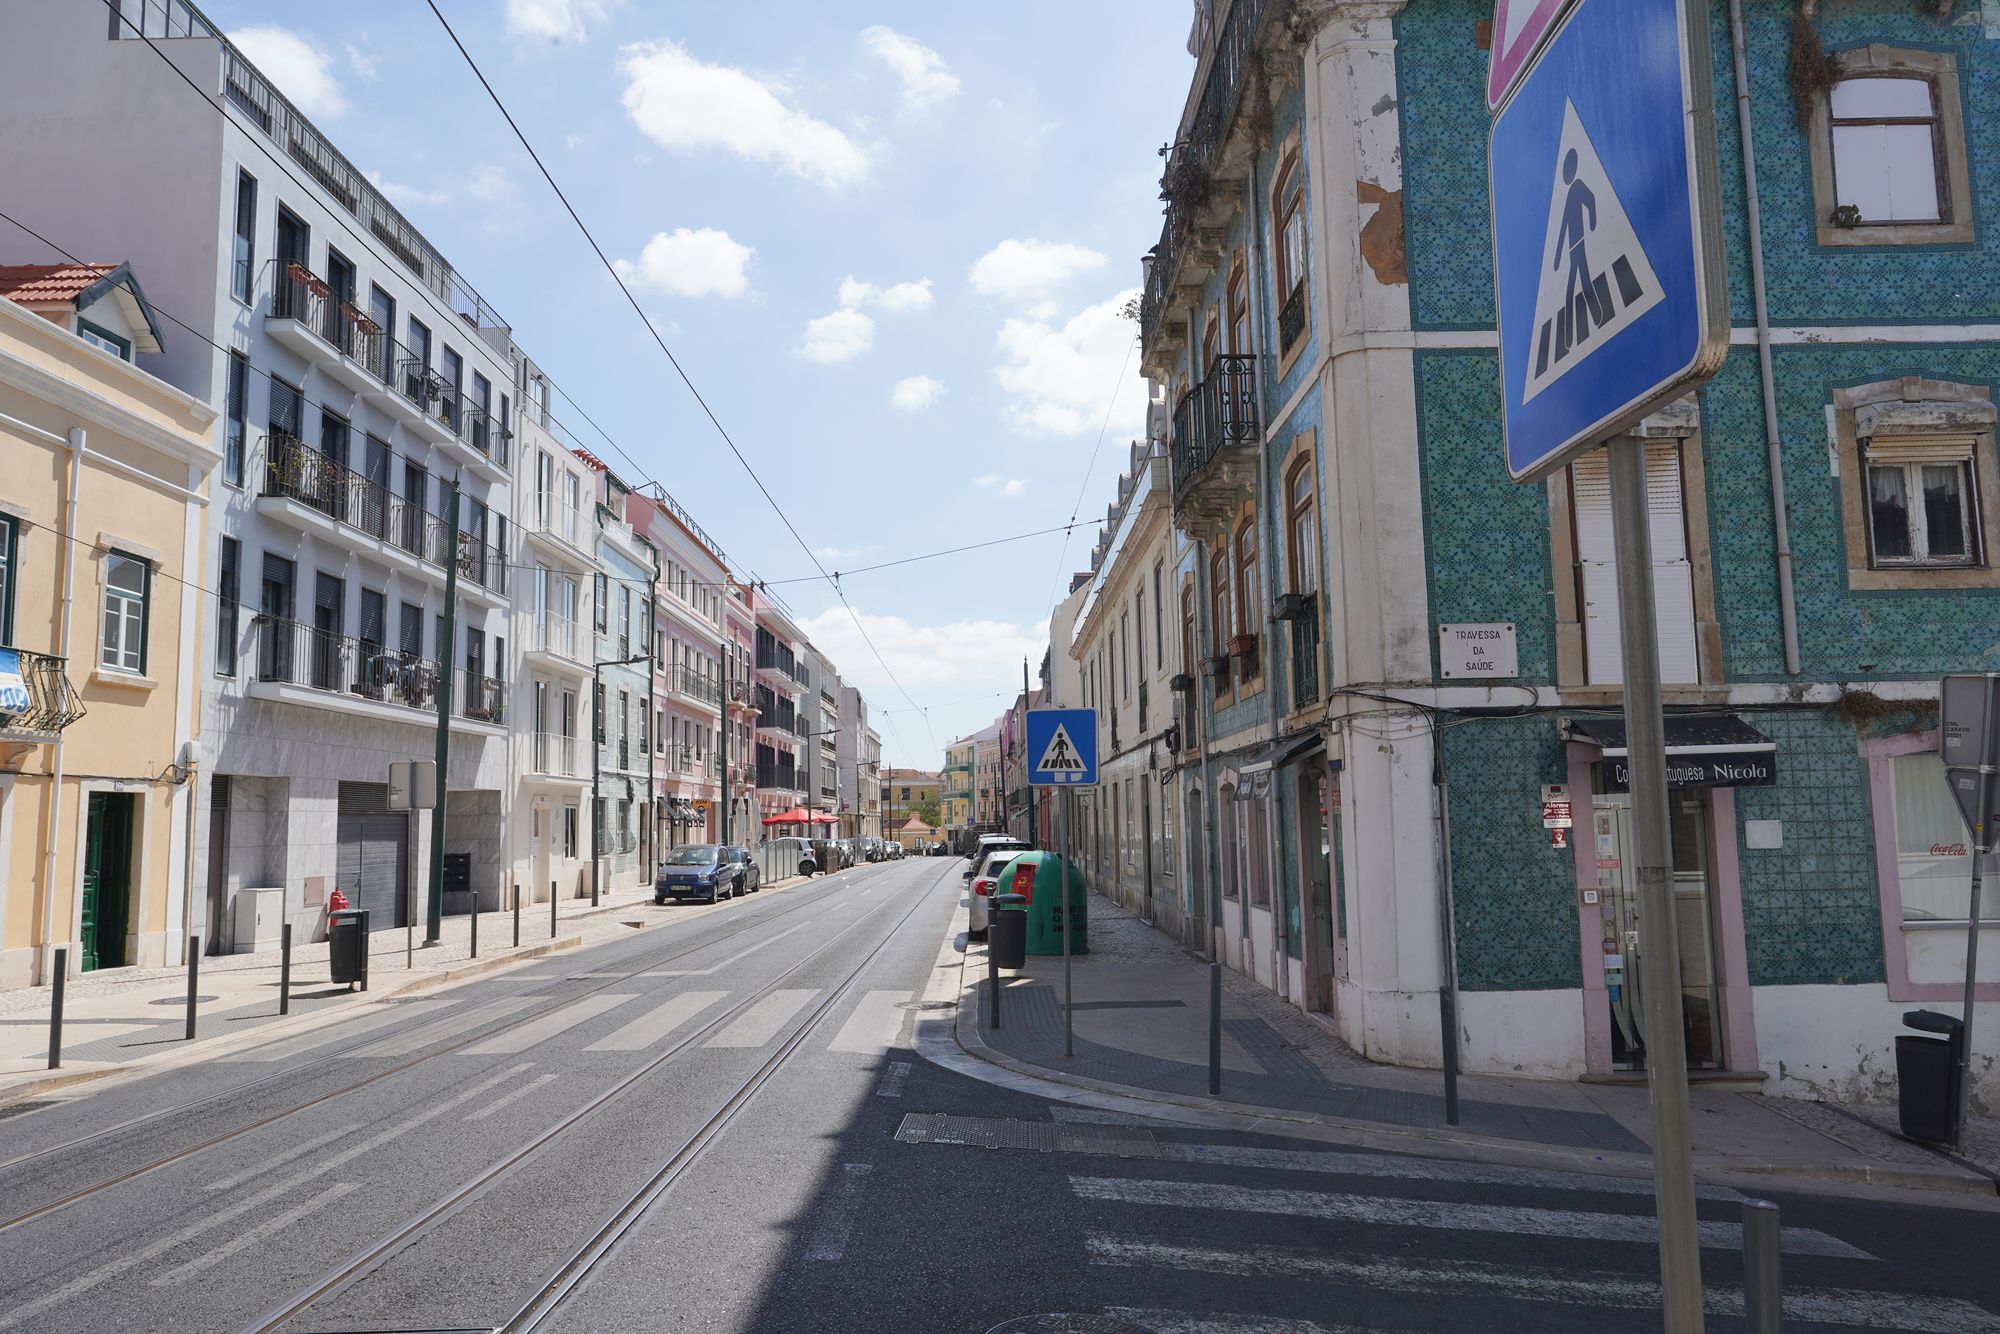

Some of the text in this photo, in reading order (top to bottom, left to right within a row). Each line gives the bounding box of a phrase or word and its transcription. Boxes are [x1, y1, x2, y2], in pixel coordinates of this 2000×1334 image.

[1456, 630, 1501, 640] TRAVESSA
[1473, 646, 1485, 655] DA
[1465, 659, 1494, 671] SAÚDE
[1713, 763, 1767, 780] Nicola
[1930, 843, 1968, 856] Coca-Cola
